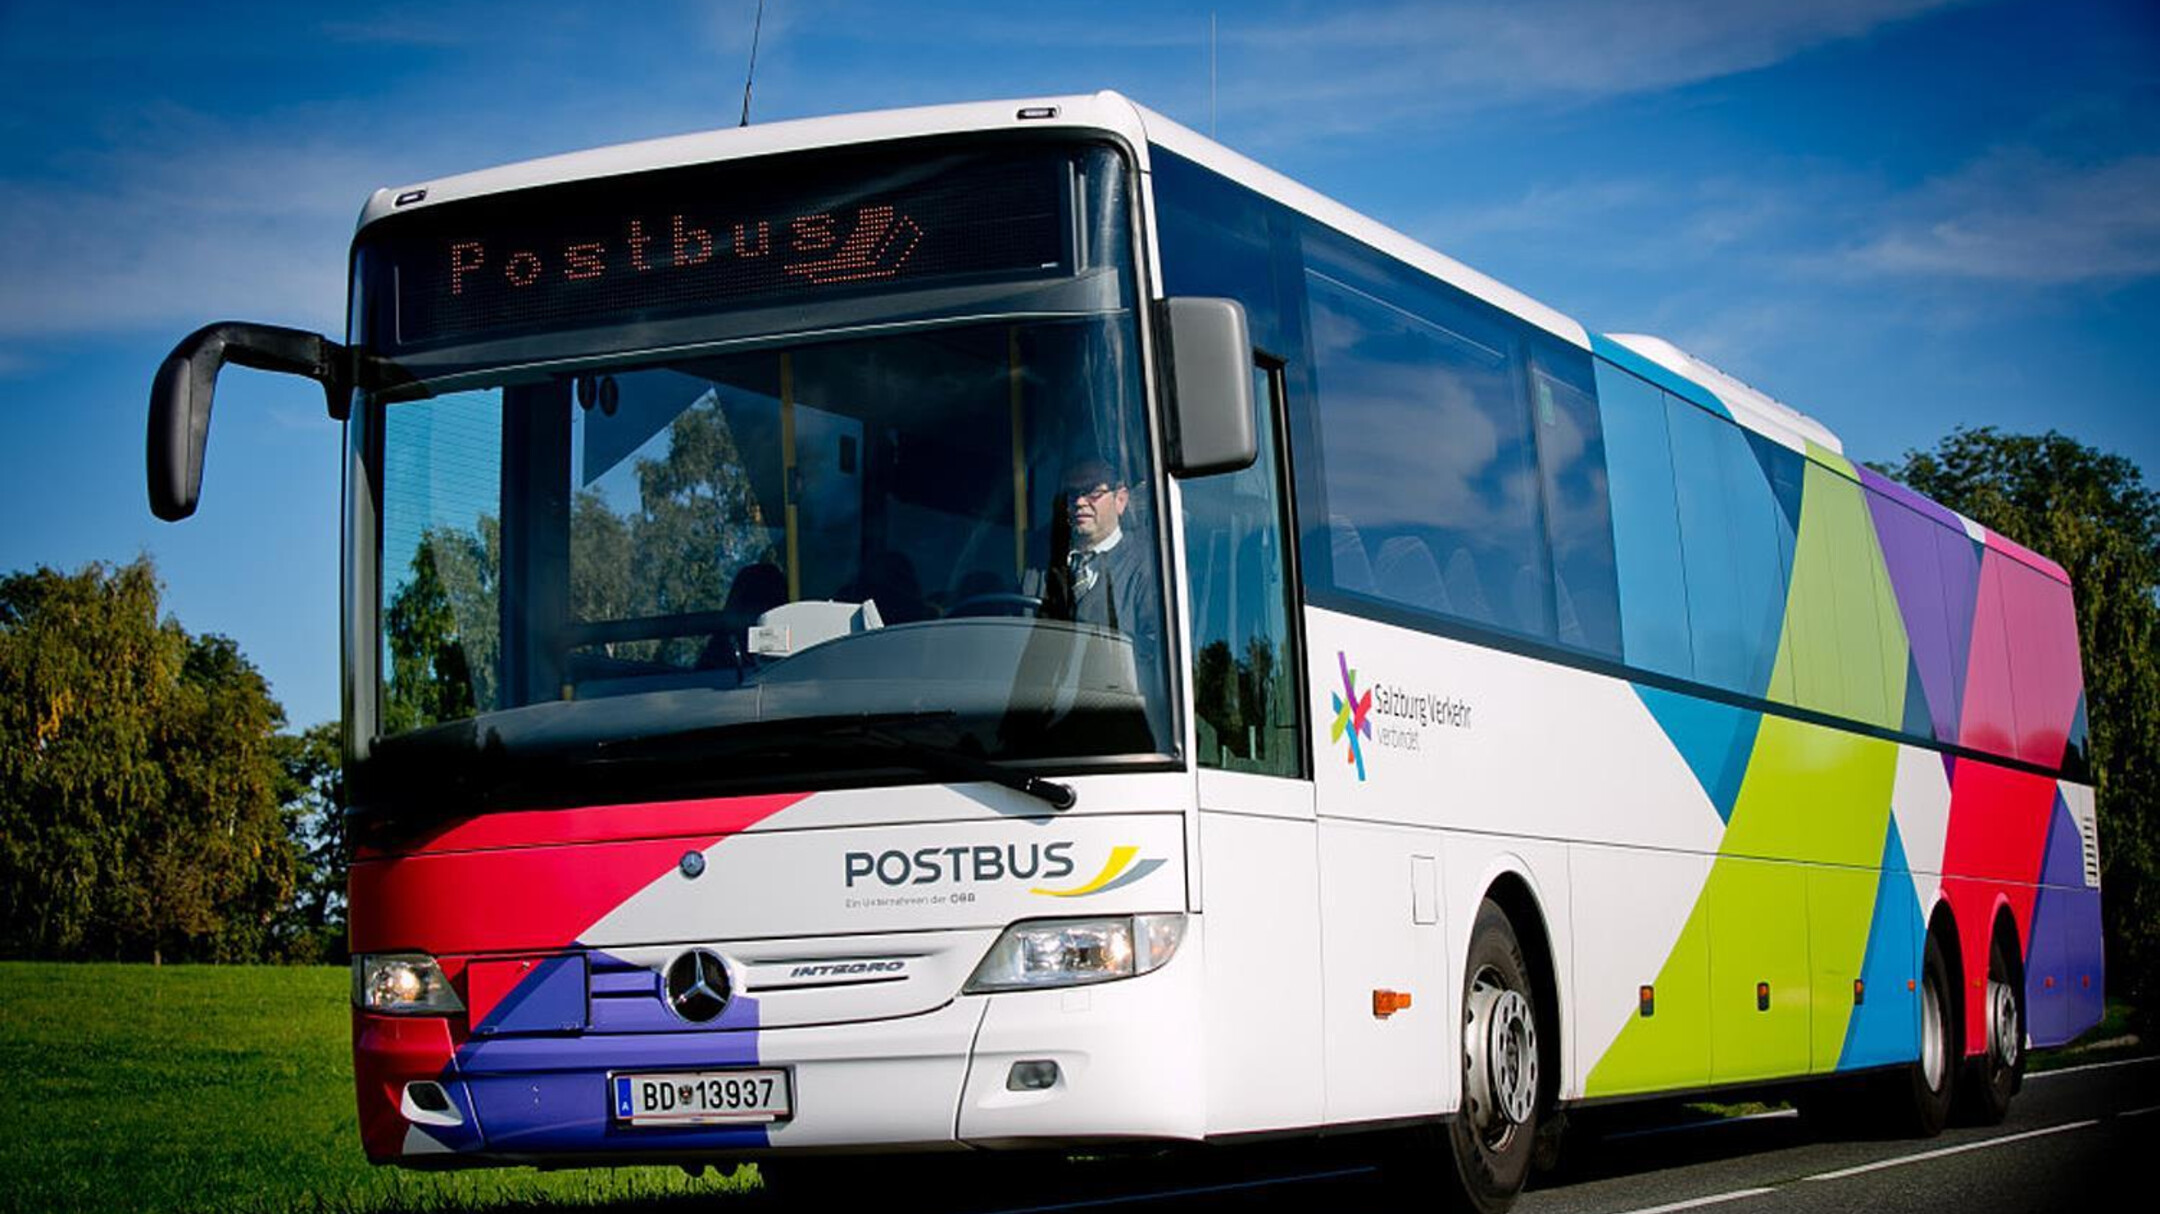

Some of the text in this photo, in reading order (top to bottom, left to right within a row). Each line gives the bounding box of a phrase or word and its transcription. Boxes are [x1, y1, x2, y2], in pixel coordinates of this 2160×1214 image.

[452, 214, 836, 294] Postbus
[1375, 683, 1472, 729] Salzburg Verkehr
[845, 841, 1075, 887] POSTBUS
[790, 961, 905, 977] INTEGRO
[642, 1078, 774, 1110] BD 13937
